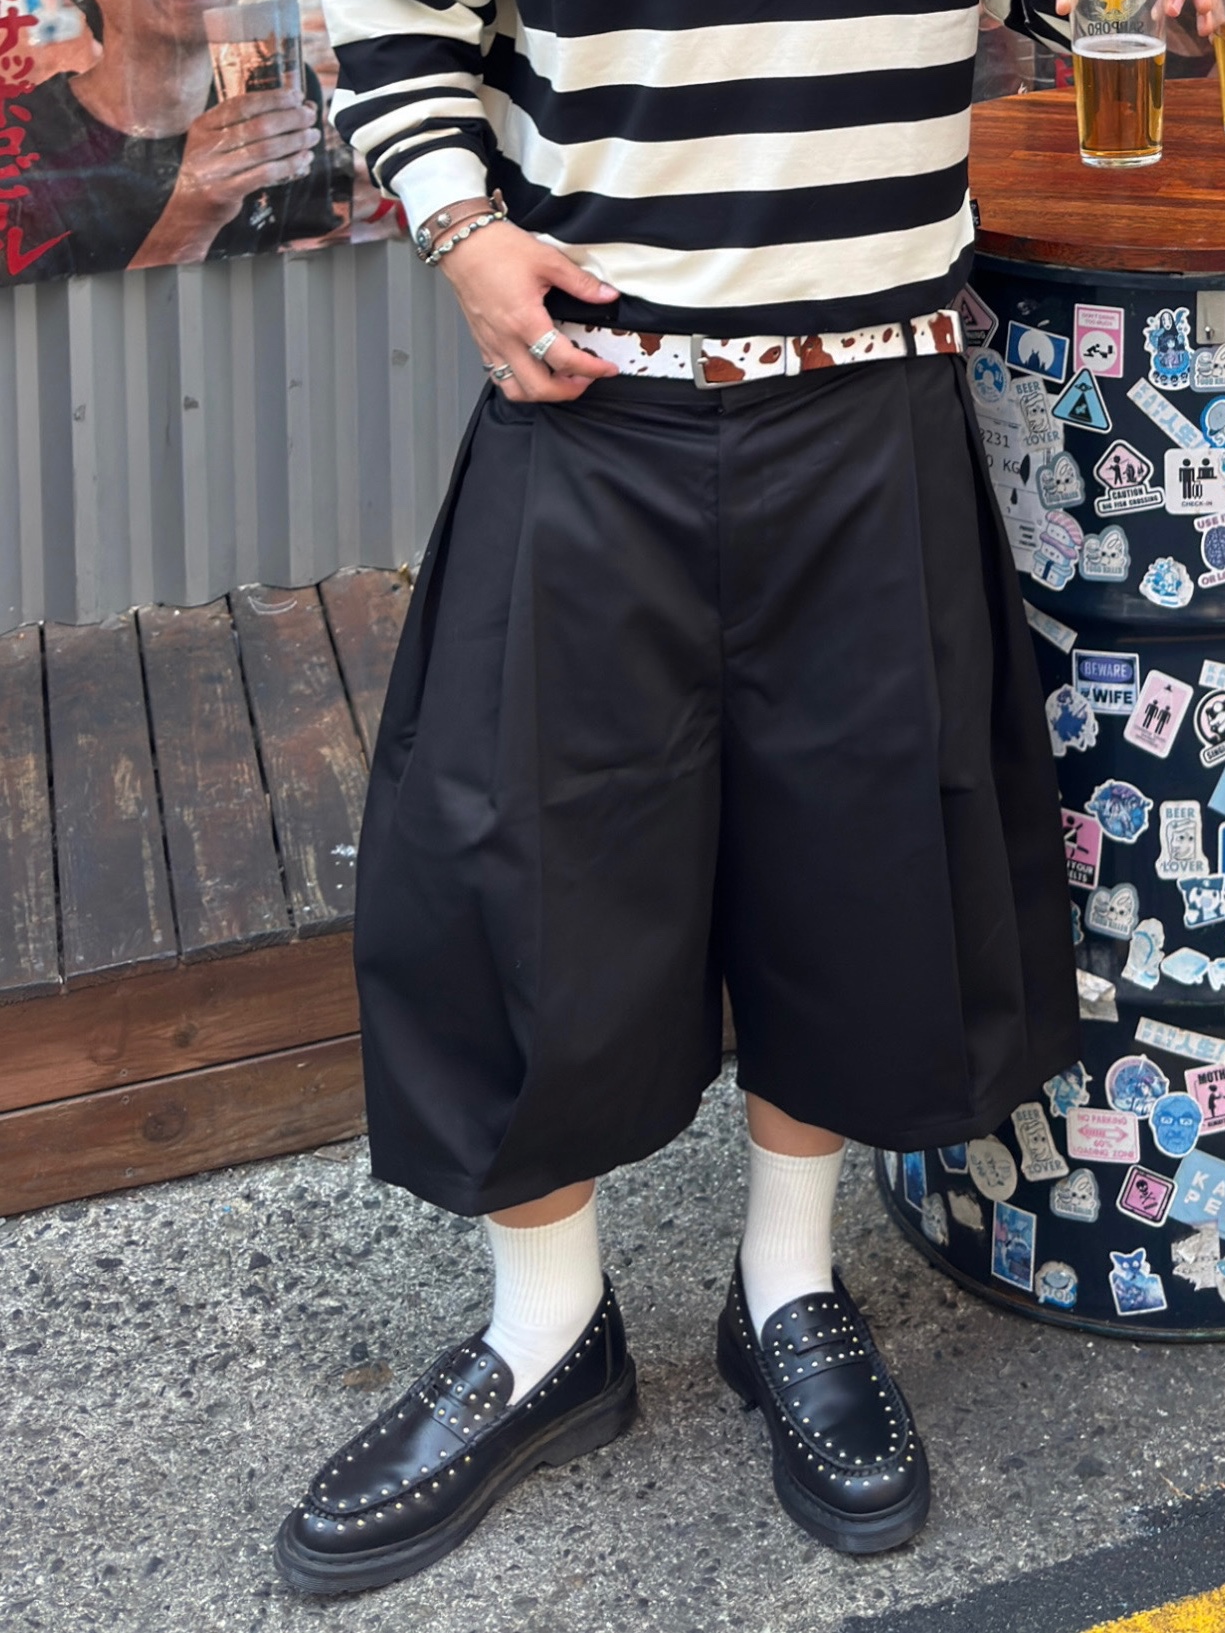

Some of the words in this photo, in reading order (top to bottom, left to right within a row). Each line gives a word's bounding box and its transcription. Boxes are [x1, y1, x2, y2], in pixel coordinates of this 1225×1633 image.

[1016, 381, 1041, 394] BEER
[1024, 431, 1060, 446] LOVER
[1112, 488, 1143, 500] CAUTION
[1182, 500, 1213, 508] CHECK-IN
[1197, 517, 1219, 528] USE
[1201, 576, 1215, 586] OR
[1085, 661, 1129, 677] BEWARE
[1093, 690, 1133, 704] WIFE
[1166, 807, 1195, 818] BEER
[1161, 859, 1204, 872] LOVER
[1069, 870, 1088, 883] ELTS
[1016, 1110, 1040, 1121] BEER
[1077, 1114, 1089, 1122] NO
[1092, 1115, 1128, 1125] PARKING
